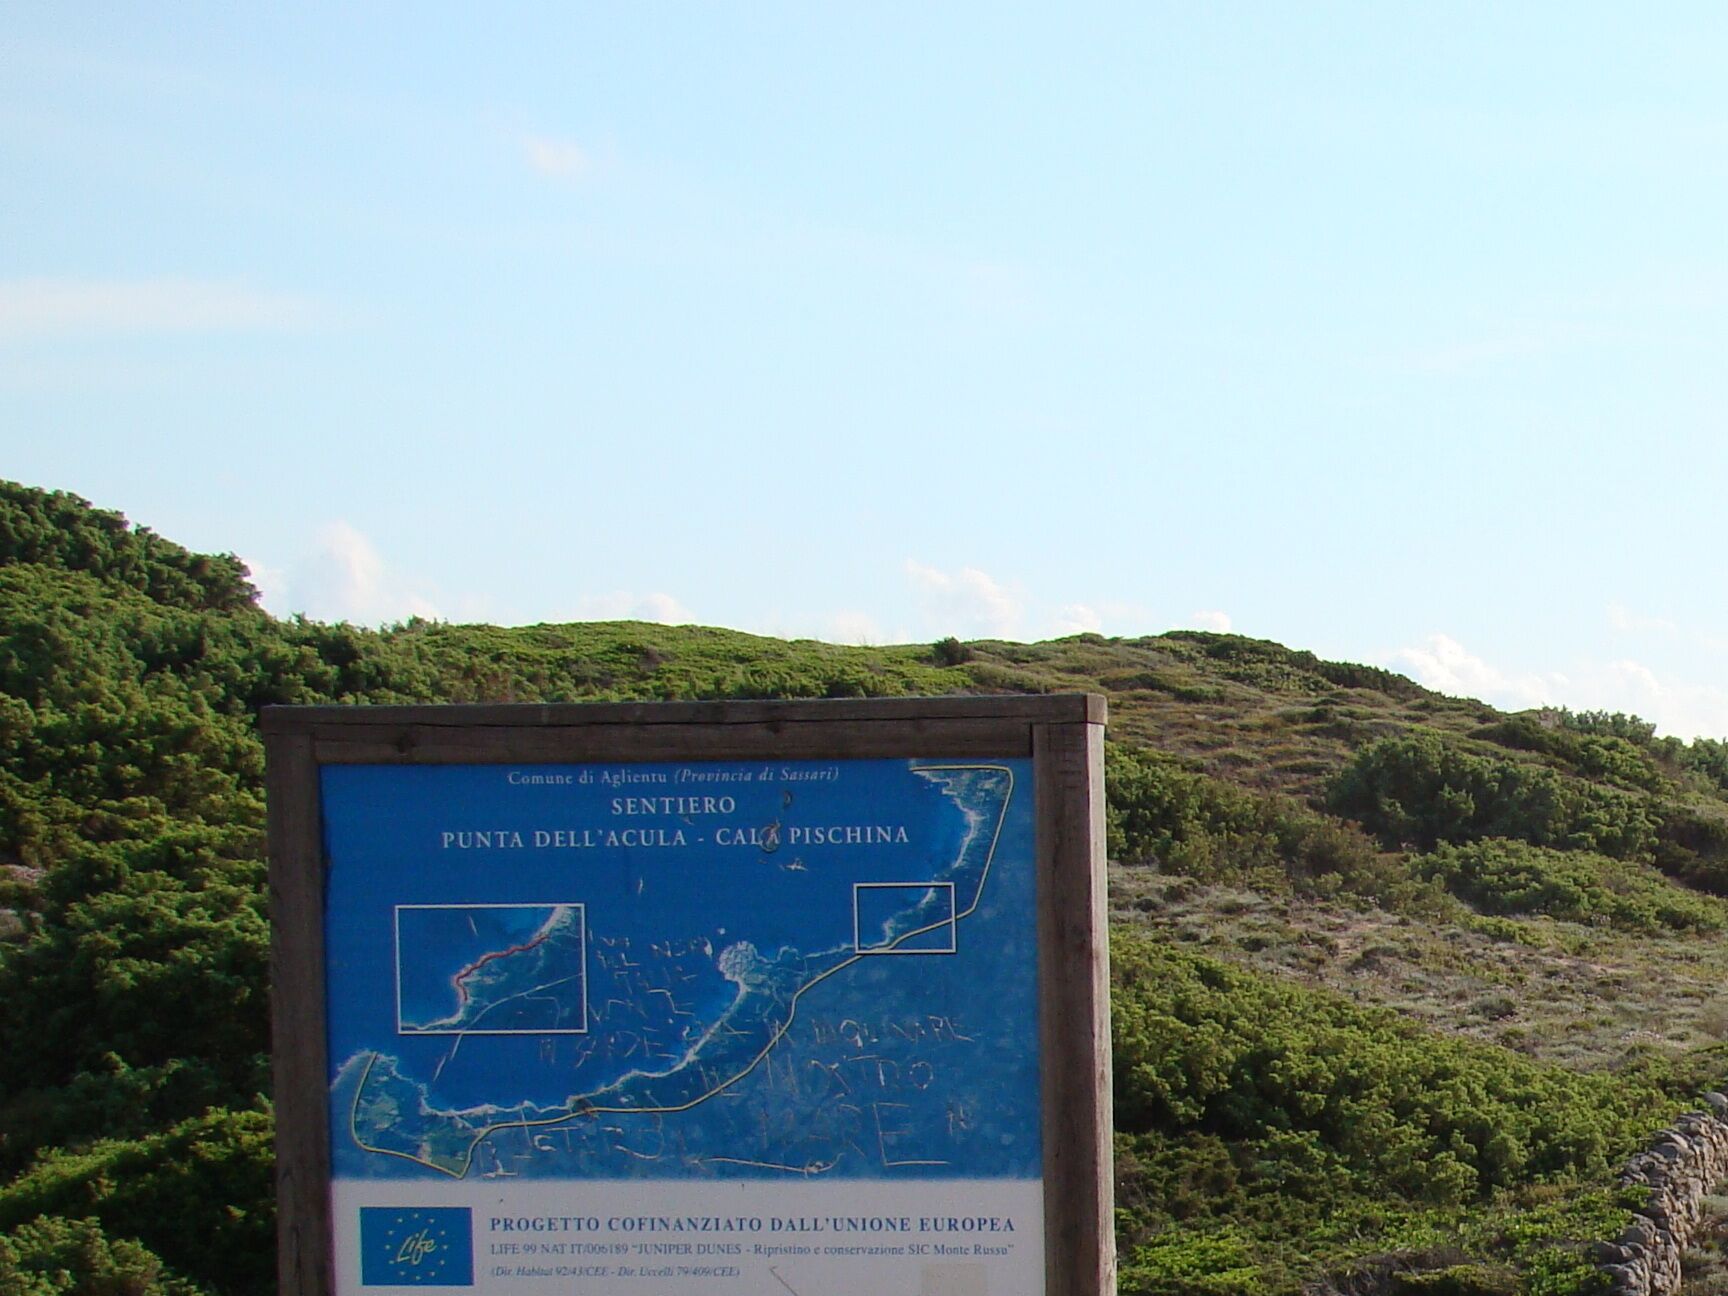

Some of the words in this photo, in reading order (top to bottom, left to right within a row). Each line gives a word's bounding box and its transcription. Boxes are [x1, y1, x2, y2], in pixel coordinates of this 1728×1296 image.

[507, 770, 573, 786] Comune
[578, 769, 594, 785] di
[601, 768, 668, 788] Aglientu
[673, 767, 752, 785] (Provincia
[758, 766, 774, 782] di
[779, 765, 840, 782] Sassari)
[611, 796, 737, 816] SENTIERO
[441, 831, 525, 849] PUNTA
[534, 828, 687, 848] DELL'ACULA
[715, 826, 780, 847] CALA
[789, 825, 910, 845] PISCHINA
[489, 1217, 600, 1232] PROGETTO
[607, 1216, 762, 1232] COFINANZIATO
[770, 1217, 912, 1232] DALL'UNIONE
[919, 1217, 1015, 1232] EUROPEA
[397, 1228, 438, 1265] Life
[490, 1243, 520, 1256] LIFE
[541, 1243, 567, 1255] NAT
[697, 1243, 742, 1255] DUNES
[754, 1243, 811, 1258] Ripristino
[813, 1246, 821, 1255] e
[824, 1243, 905, 1255] conservazione
[908, 1243, 930, 1255] SIC
[933, 1243, 969, 1255] Monte
